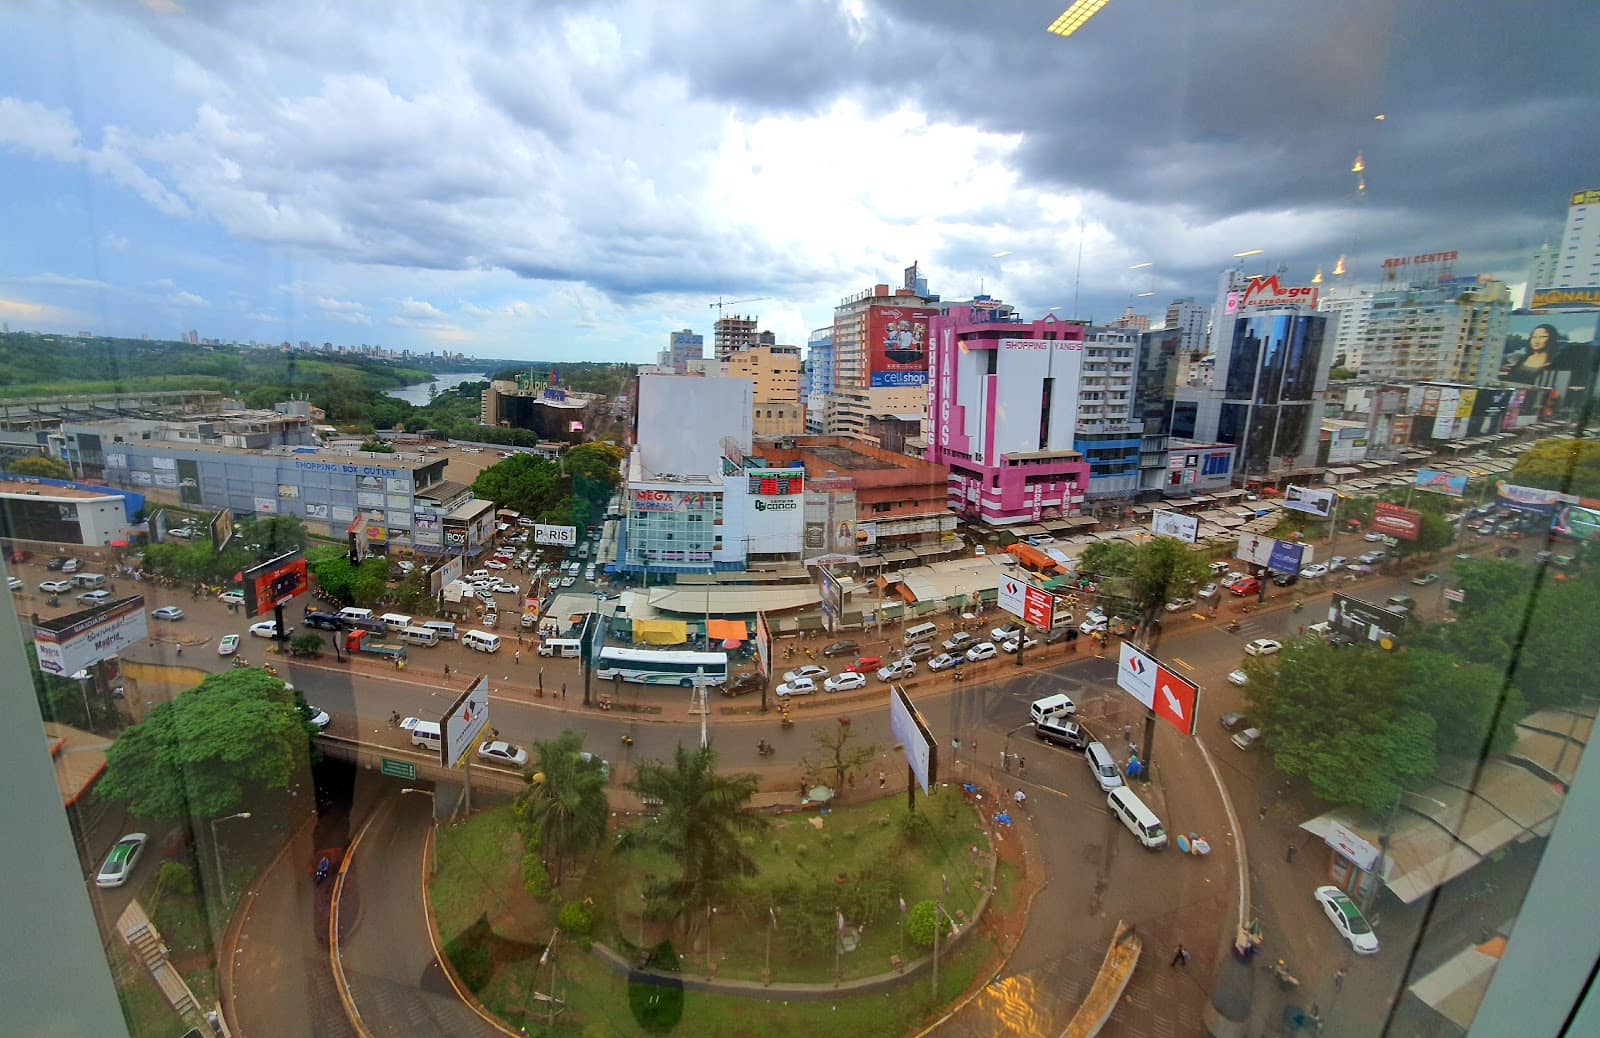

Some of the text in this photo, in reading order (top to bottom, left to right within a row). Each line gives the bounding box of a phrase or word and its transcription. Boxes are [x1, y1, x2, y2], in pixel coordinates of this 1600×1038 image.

[1414, 251, 1458, 265] CENTER
[1005, 341, 1047, 350] SHOPPING
[928, 338, 936, 445] SHOPPING
[295, 461, 337, 471] SHOPPING
[364, 467, 396, 476] OUTLET
[637, 490, 673, 501] MEGA
[447, 533, 465, 543] BOX
